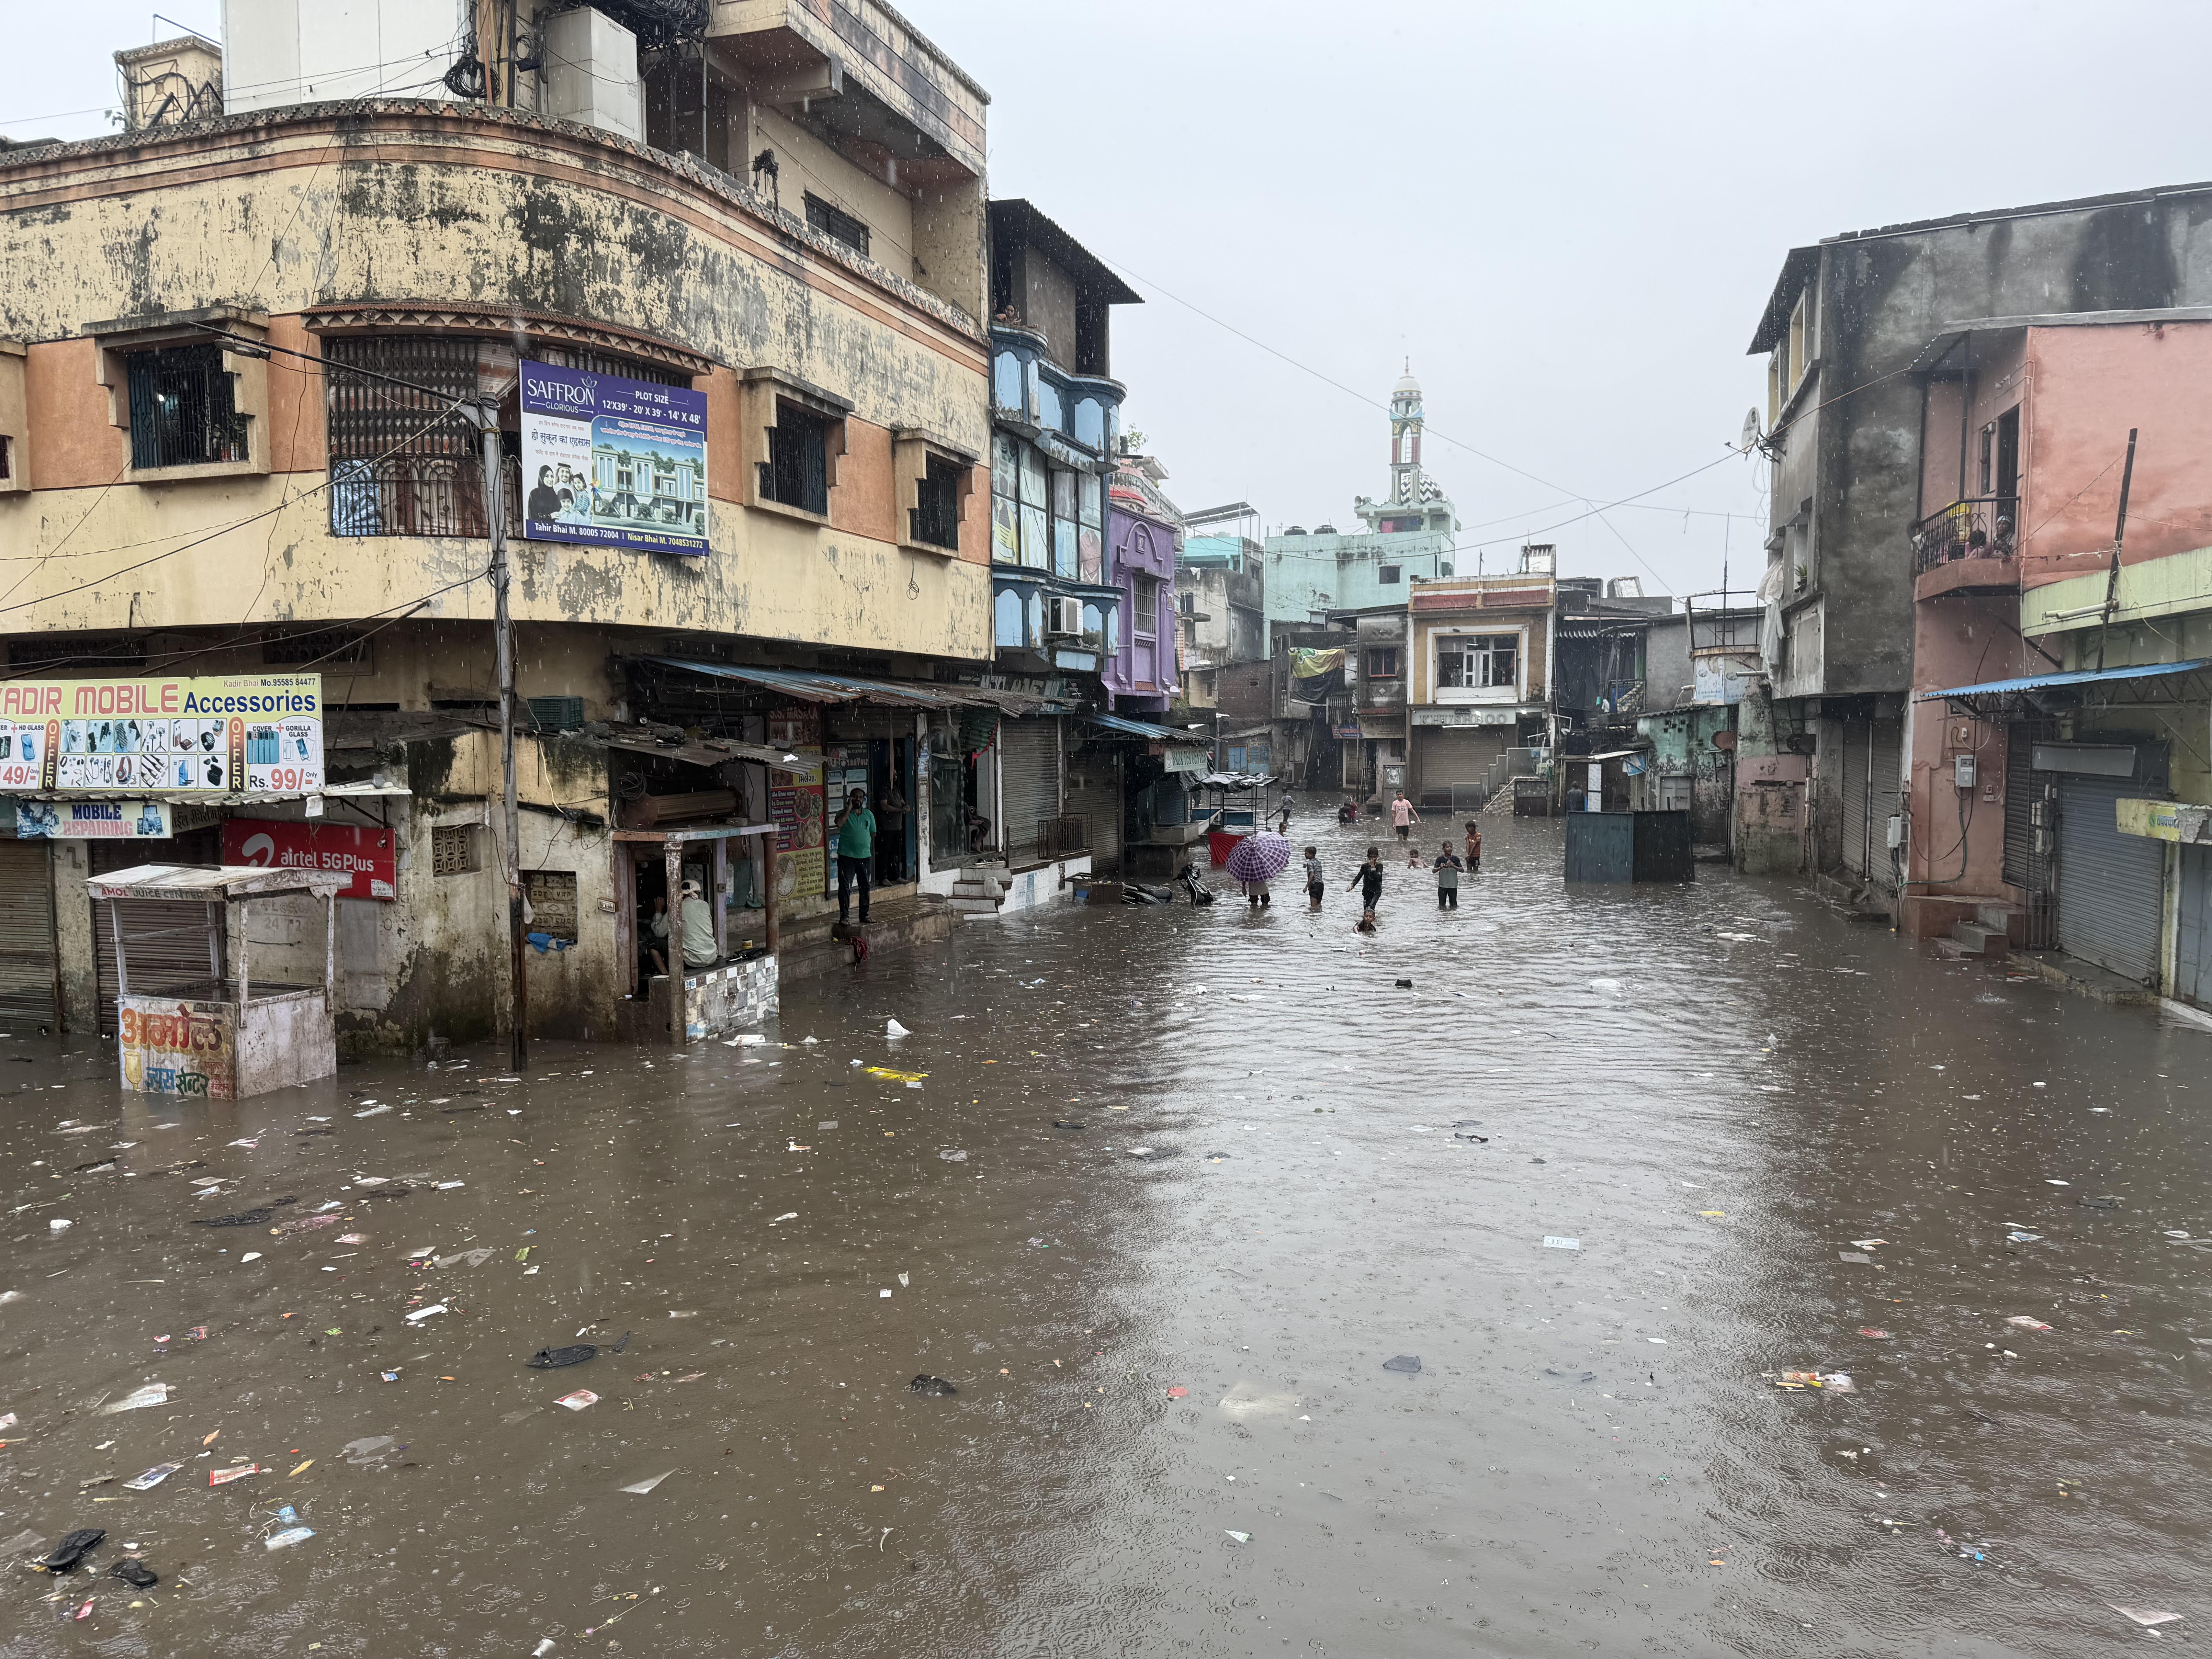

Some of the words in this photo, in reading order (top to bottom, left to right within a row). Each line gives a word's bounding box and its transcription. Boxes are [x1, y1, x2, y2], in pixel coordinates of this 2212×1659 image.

[527, 378, 594, 406] SAFFRON
[635, 390, 652, 402] PLOT
[654, 394, 669, 405] SIZE
[545, 401, 579, 413] GLORIOUS
[634, 405, 644, 414] 20'
[645, 407, 650, 415] X
[652, 408, 662, 417] 39'
[668, 410, 680, 420] 14'
[681, 413, 687, 422] X
[689, 413, 701, 424] 48'
[531, 428, 538, 440] हो
[559, 435, 568, 444] का
[570, 437, 591, 447] एहसास
[535, 523, 551, 532] Tahir
[553, 524, 567, 534] Bhai
[569, 527, 577, 535] M.
[579, 528, 598, 537] 80005
[599, 529, 618, 539] 72004
[628, 532, 643, 542] Nisar
[645, 534, 658, 543] Bhai
[659, 536, 667, 545] M.
[668, 538, 702, 548] 7048531272
[0, 687, 62, 715] ADIR
[75, 684, 178, 714] MOBILE
[184, 689, 316, 713] Accessories
[1419, 714, 1507, 725] KHUSHBOO
[45, 723, 57, 787] OFFER
[232, 721, 241, 788] OFFER
[249, 775, 269, 788] Rs.
[271, 768, 313, 790] 99/-
[72, 804, 122, 820] MOBILE
[63, 821, 133, 836] REPAIRING
[281, 847, 318, 867] airtel
[101, 888, 129, 896] AMOL
[133, 889, 160, 898] JUICE
[164, 890, 203, 900] CENTER
[120, 1003, 222, 1051] अमोल
